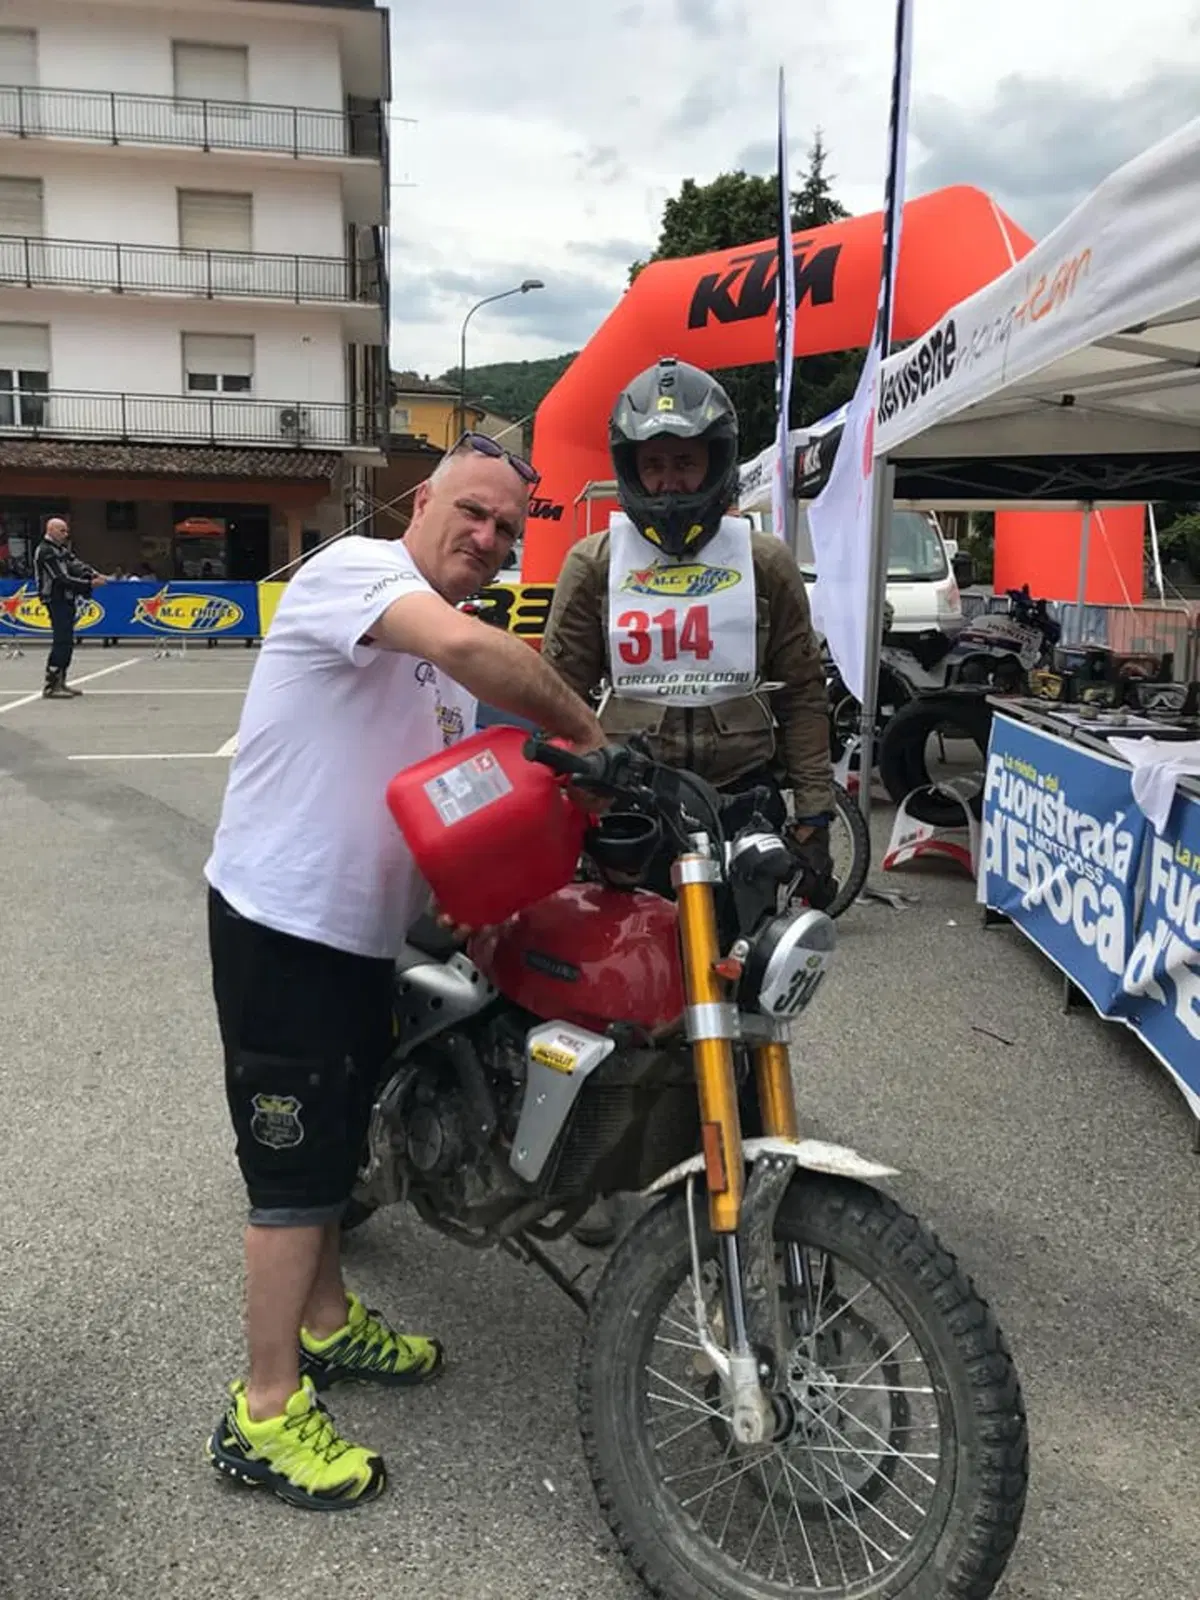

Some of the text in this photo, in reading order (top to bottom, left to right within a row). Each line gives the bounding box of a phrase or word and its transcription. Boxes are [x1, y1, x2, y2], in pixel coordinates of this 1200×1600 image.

[687, 239, 842, 330] KTM
[159, 606, 186, 618] M.C.
[616, 604, 714, 666] 314
[617, 672, 680, 687] CIRCOLO
